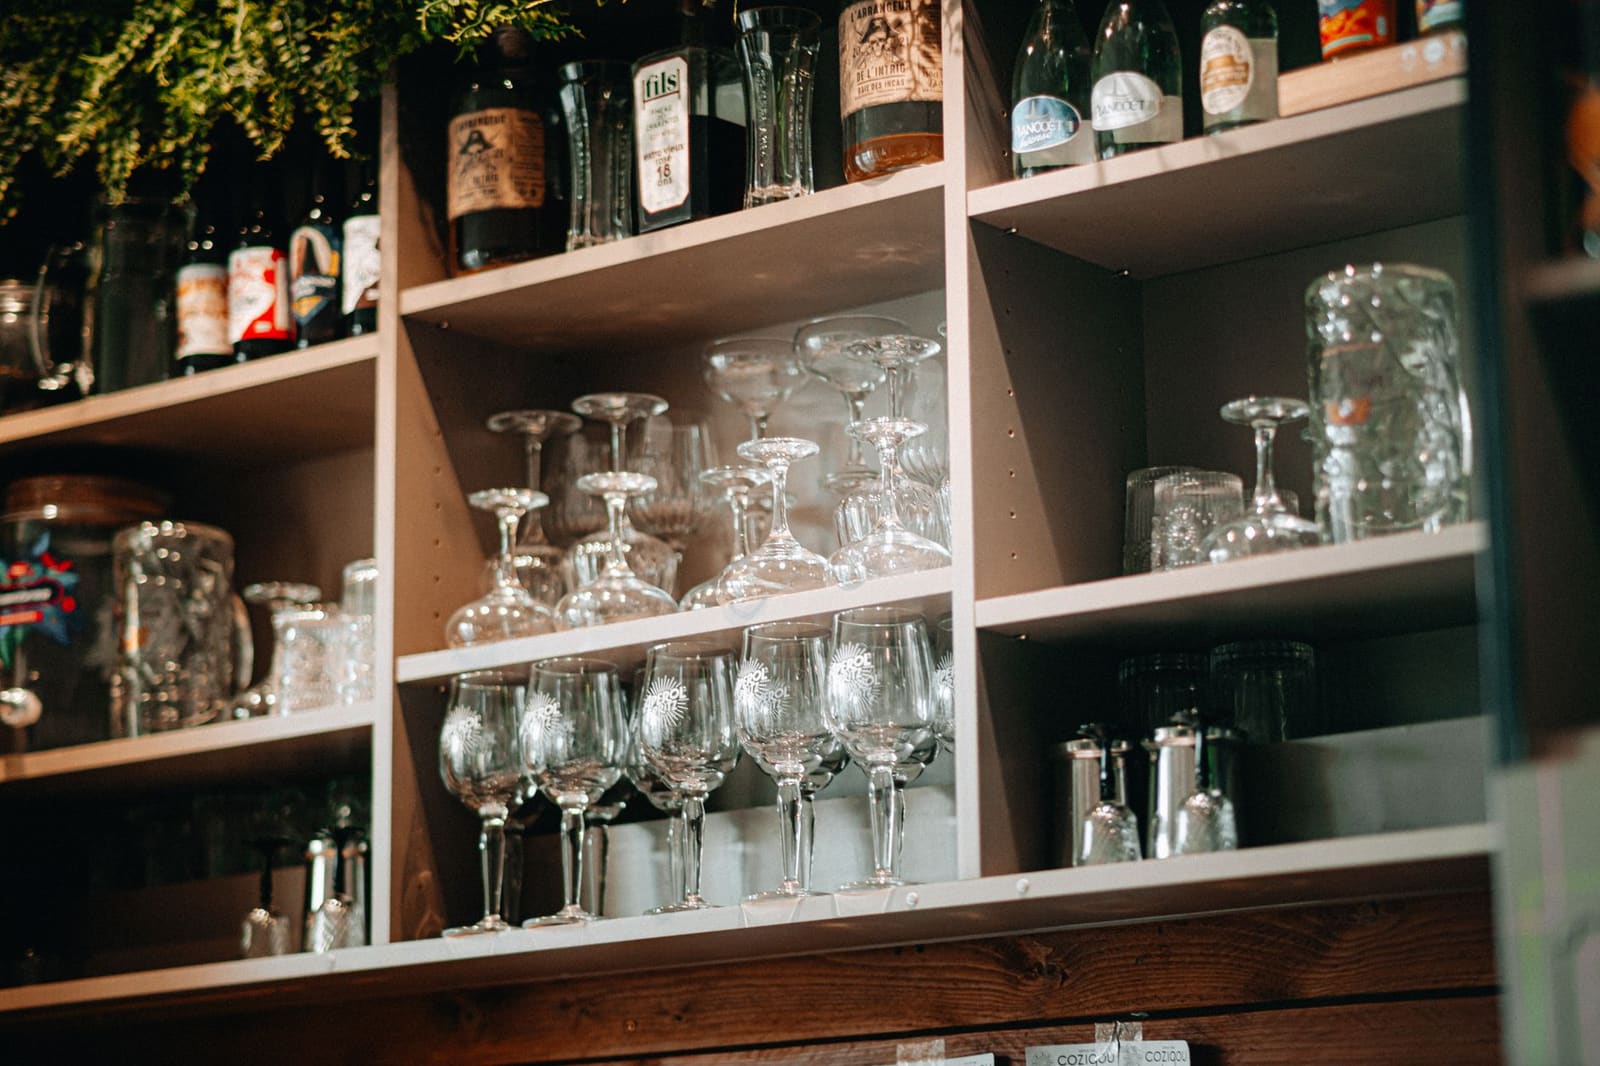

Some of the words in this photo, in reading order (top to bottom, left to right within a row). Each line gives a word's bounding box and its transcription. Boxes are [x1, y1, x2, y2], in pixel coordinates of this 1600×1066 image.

[850, 0, 912, 23] L'ARRANGEUR
[645, 71, 678, 98] fils
[856, 70, 865, 82] DE
[1057, 1050, 1115, 1066] COZIGOU
